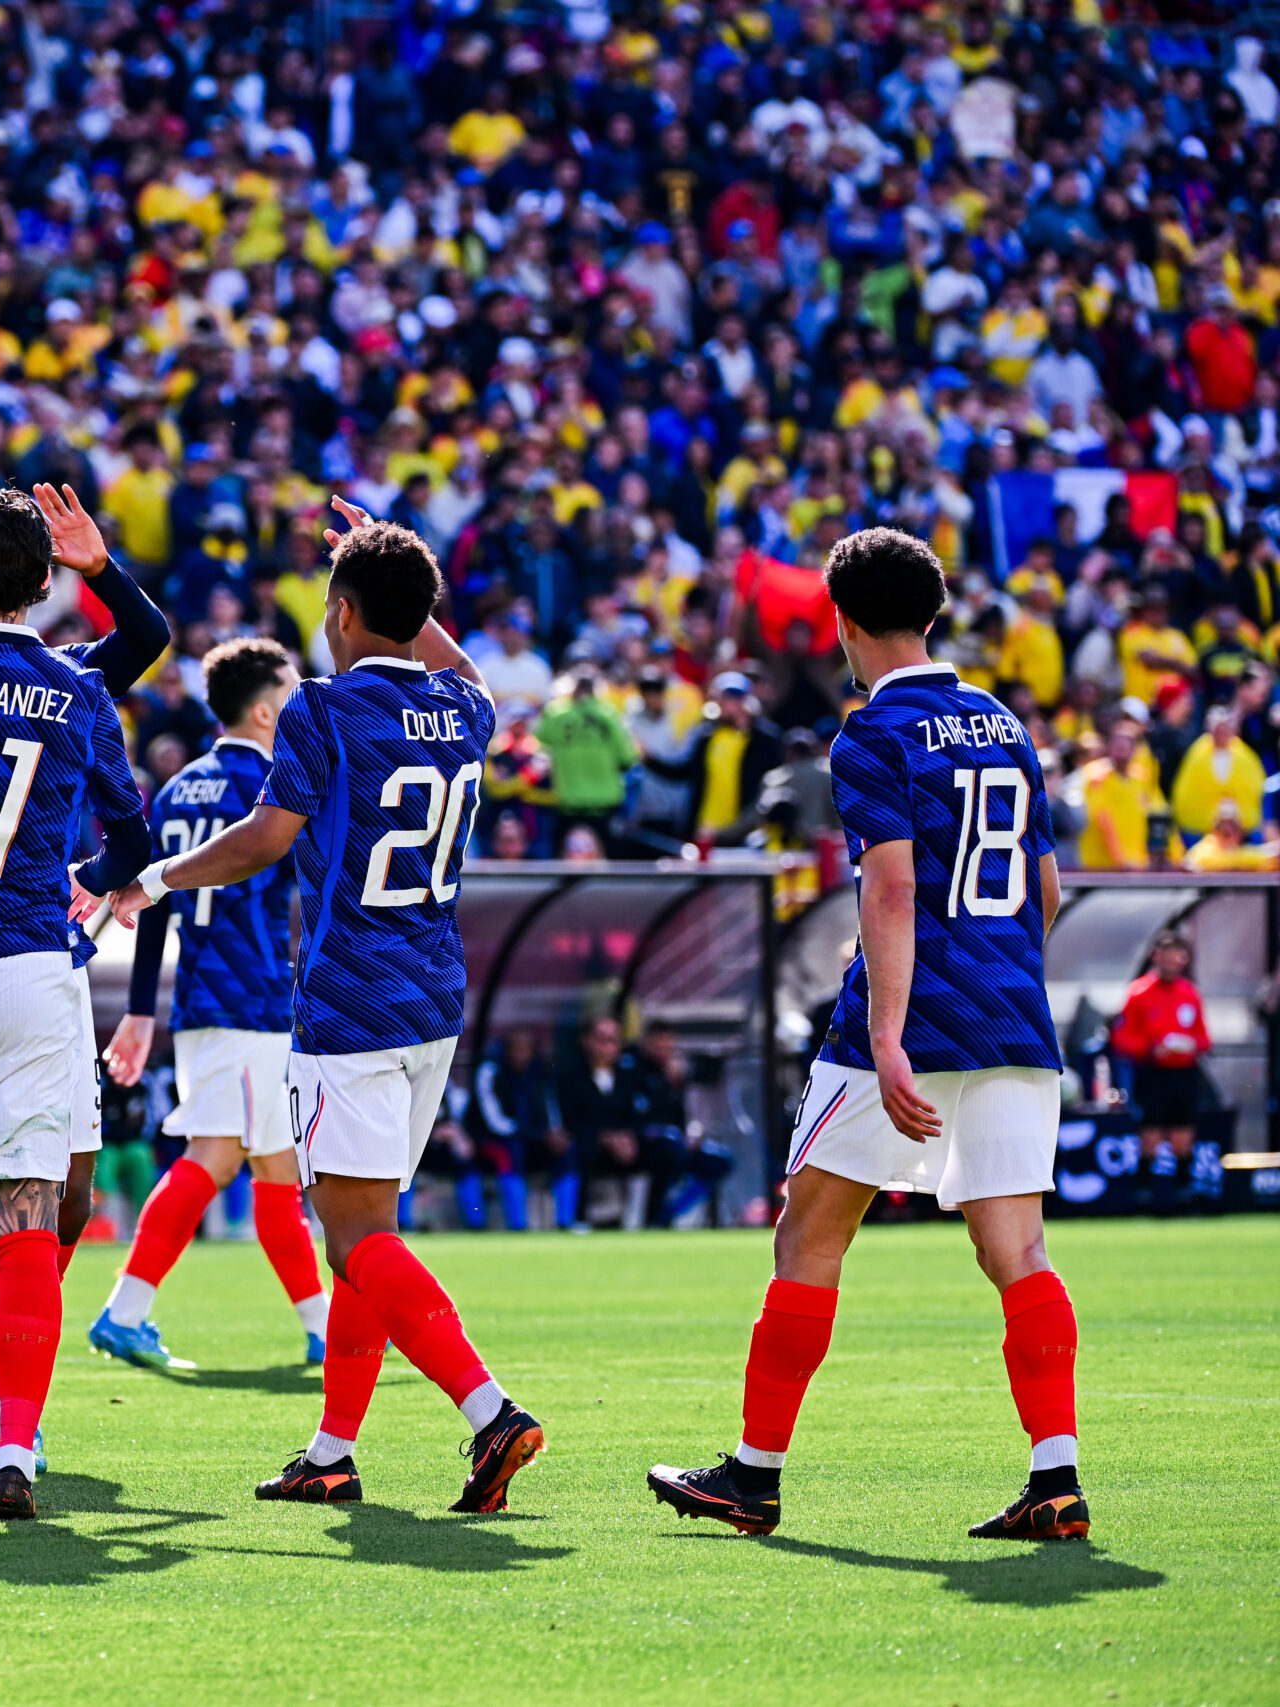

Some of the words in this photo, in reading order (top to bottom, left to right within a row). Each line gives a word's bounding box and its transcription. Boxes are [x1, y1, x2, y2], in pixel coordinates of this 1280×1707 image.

[402, 708, 464, 742] DOUE
[170, 778, 229, 805] CHERKI
[360, 761, 483, 907] 20
[947, 767, 1030, 918] 18
[6, 1332, 49, 1343] FFF
